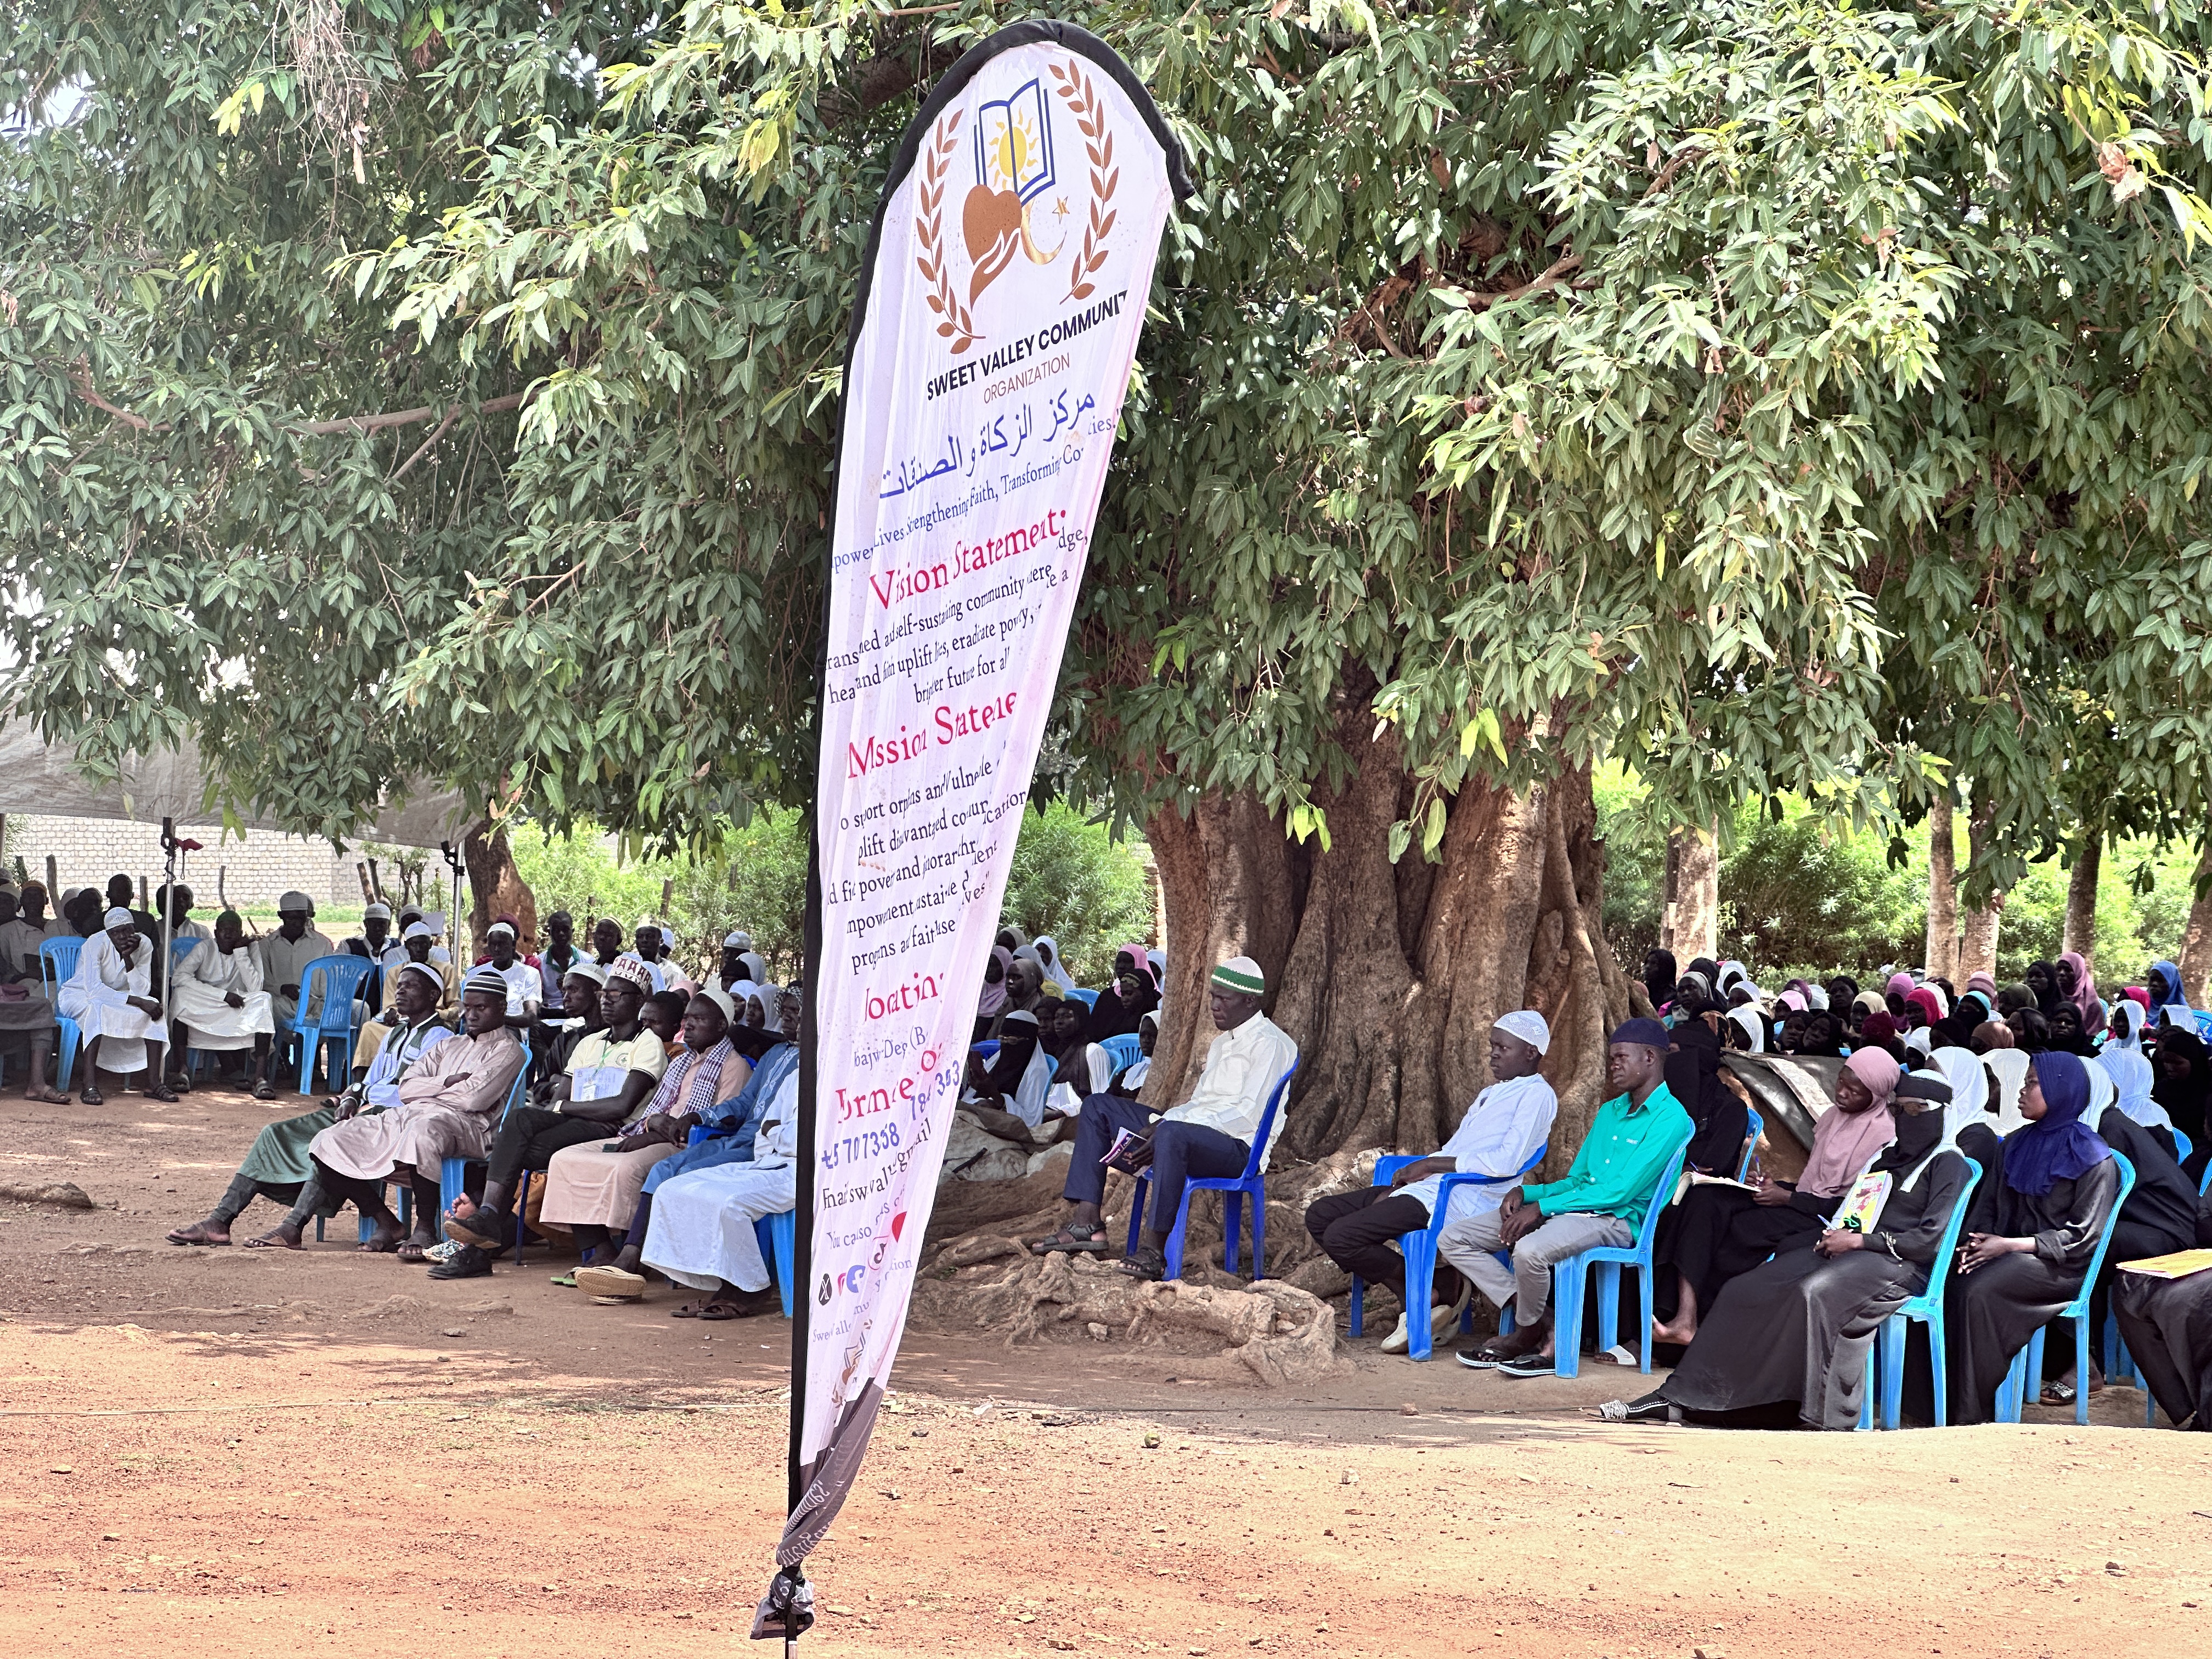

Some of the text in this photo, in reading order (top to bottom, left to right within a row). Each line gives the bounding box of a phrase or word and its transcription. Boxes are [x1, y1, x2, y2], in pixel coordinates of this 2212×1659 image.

[927, 360, 977, 401] SWEET
[980, 334, 1035, 377] VALLEY
[984, 352, 1070, 404] ORGANIZATION
[980, 403, 1032, 457] الزكاة
[1042, 387, 1095, 442] مركز
[869, 562, 949, 610] Vision
[897, 644, 933, 678] uplift
[977, 654, 996, 677] for
